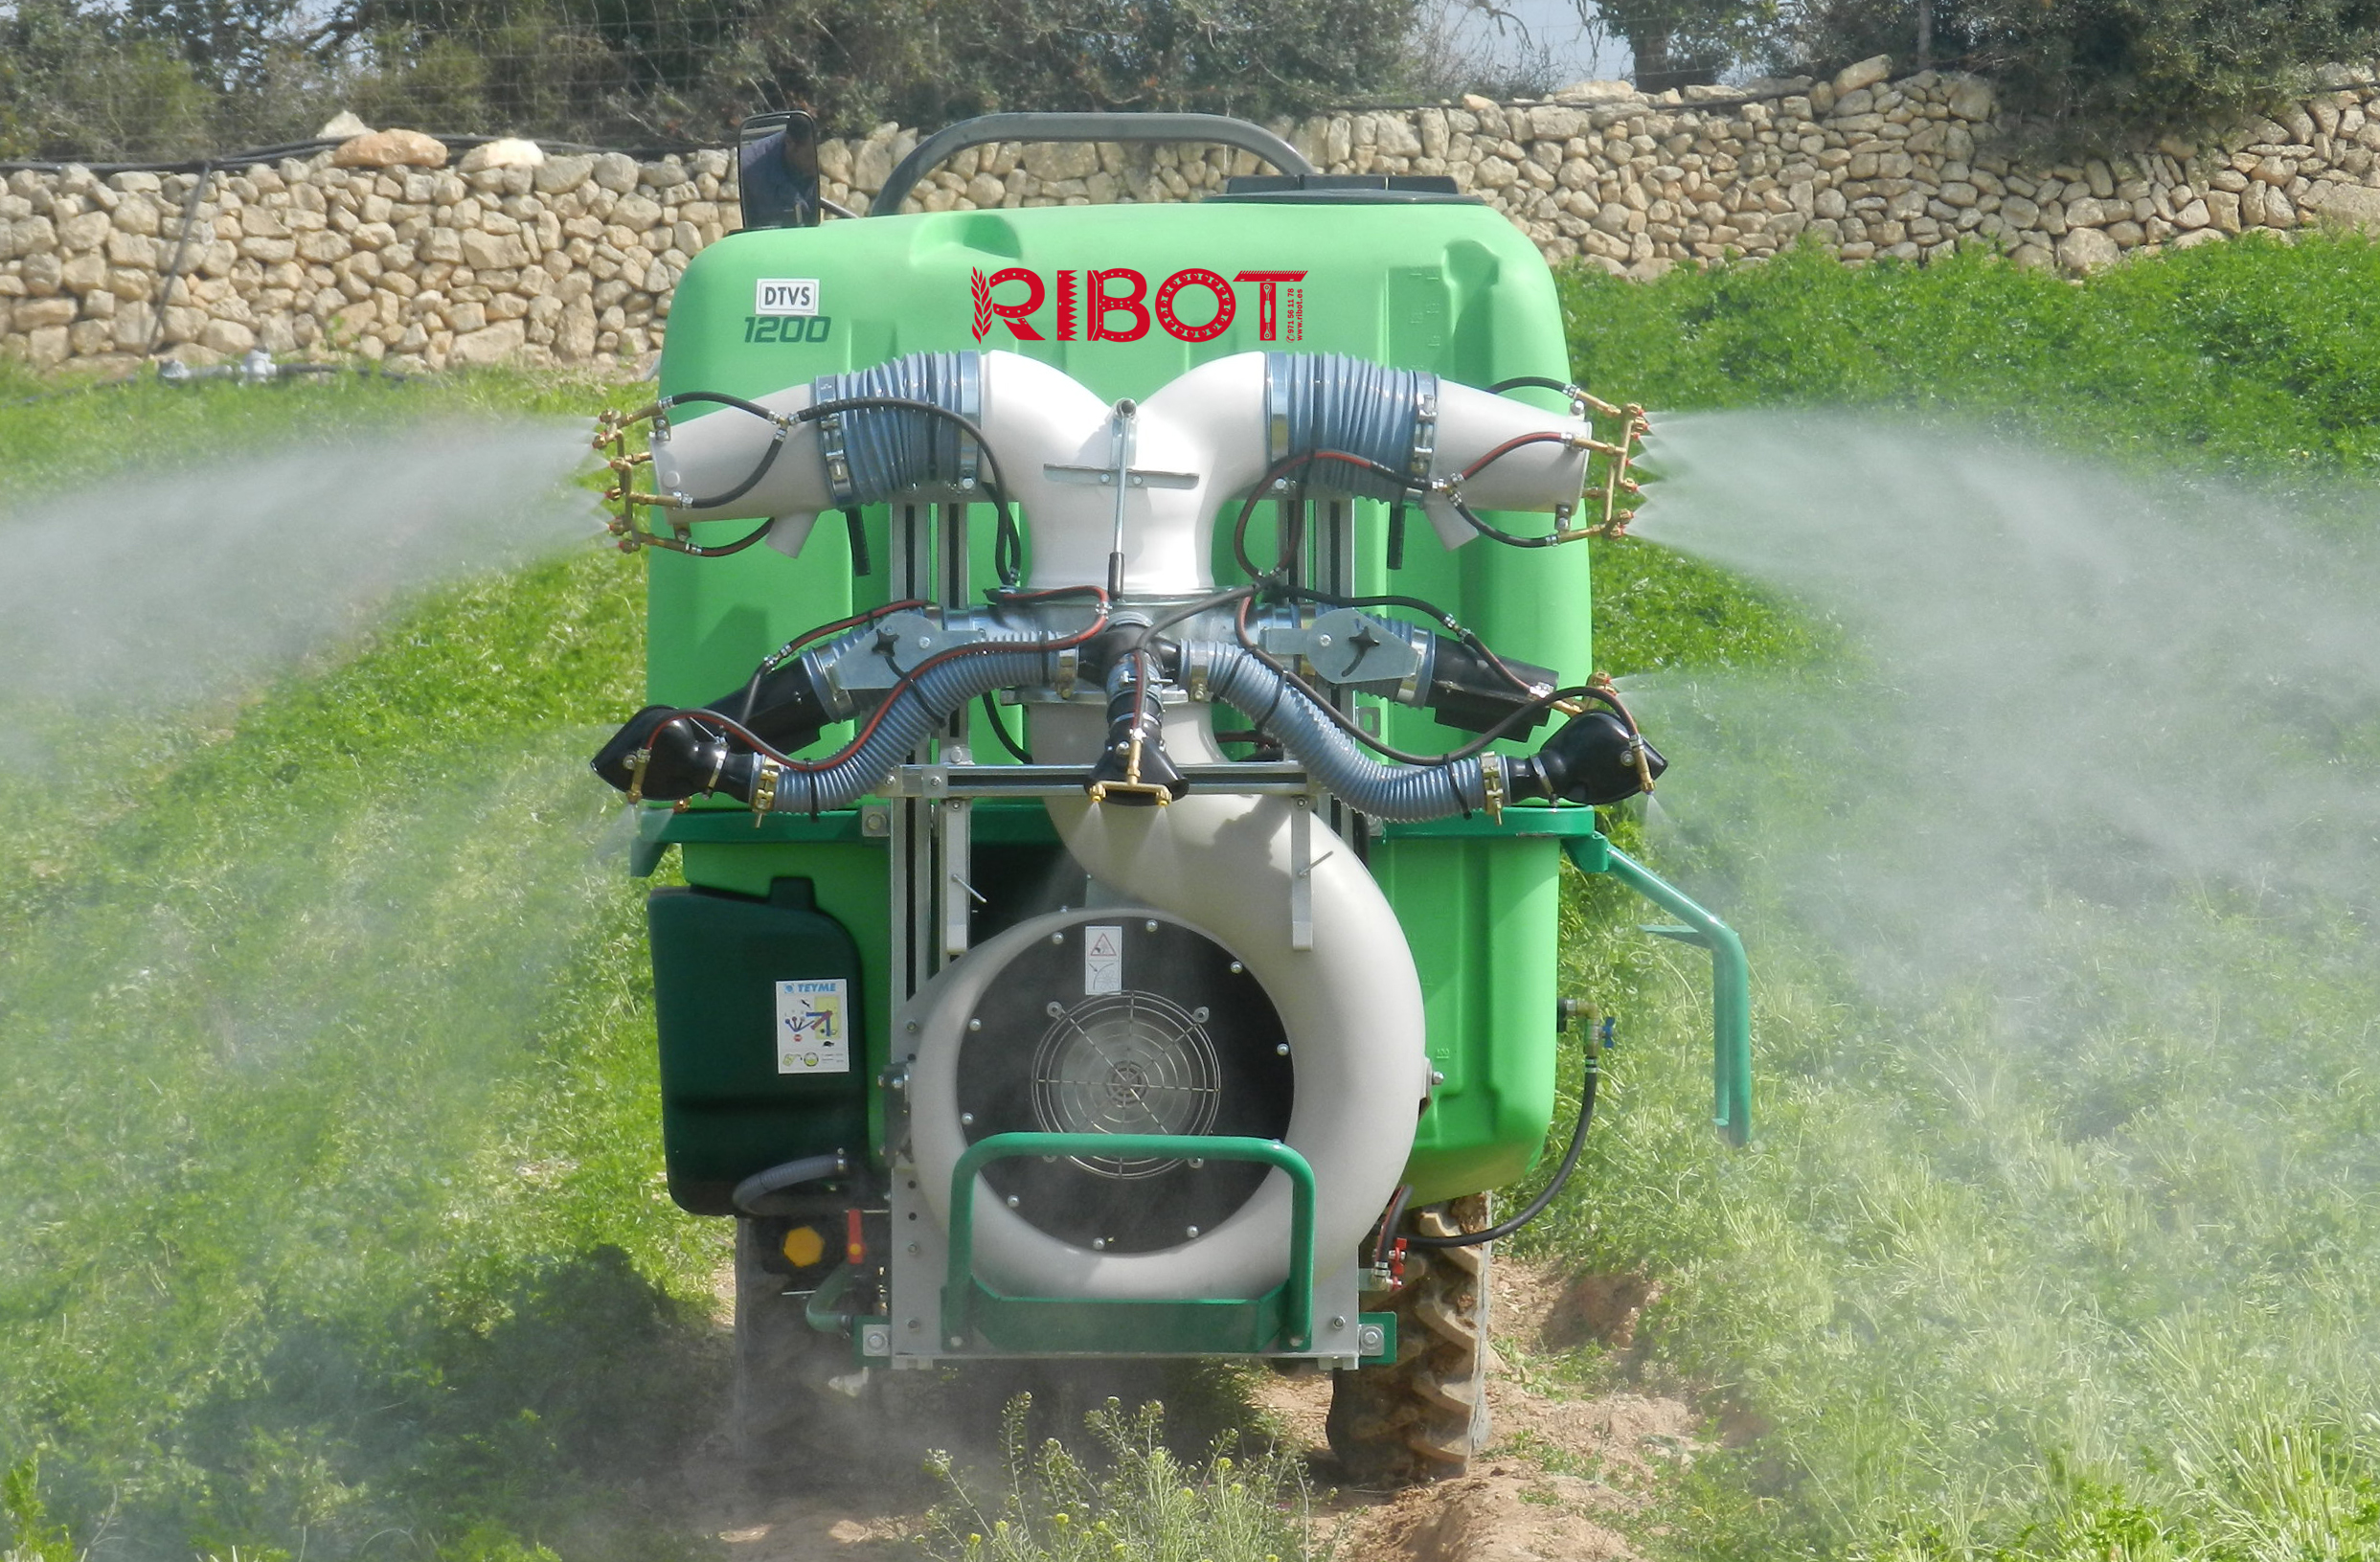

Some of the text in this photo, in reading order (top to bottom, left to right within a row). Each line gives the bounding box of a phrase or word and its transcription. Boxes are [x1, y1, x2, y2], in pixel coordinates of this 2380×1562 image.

[764, 286, 811, 306] DTVS
[744, 316, 831, 343] 1200
[797, 983, 837, 992] TEYME
